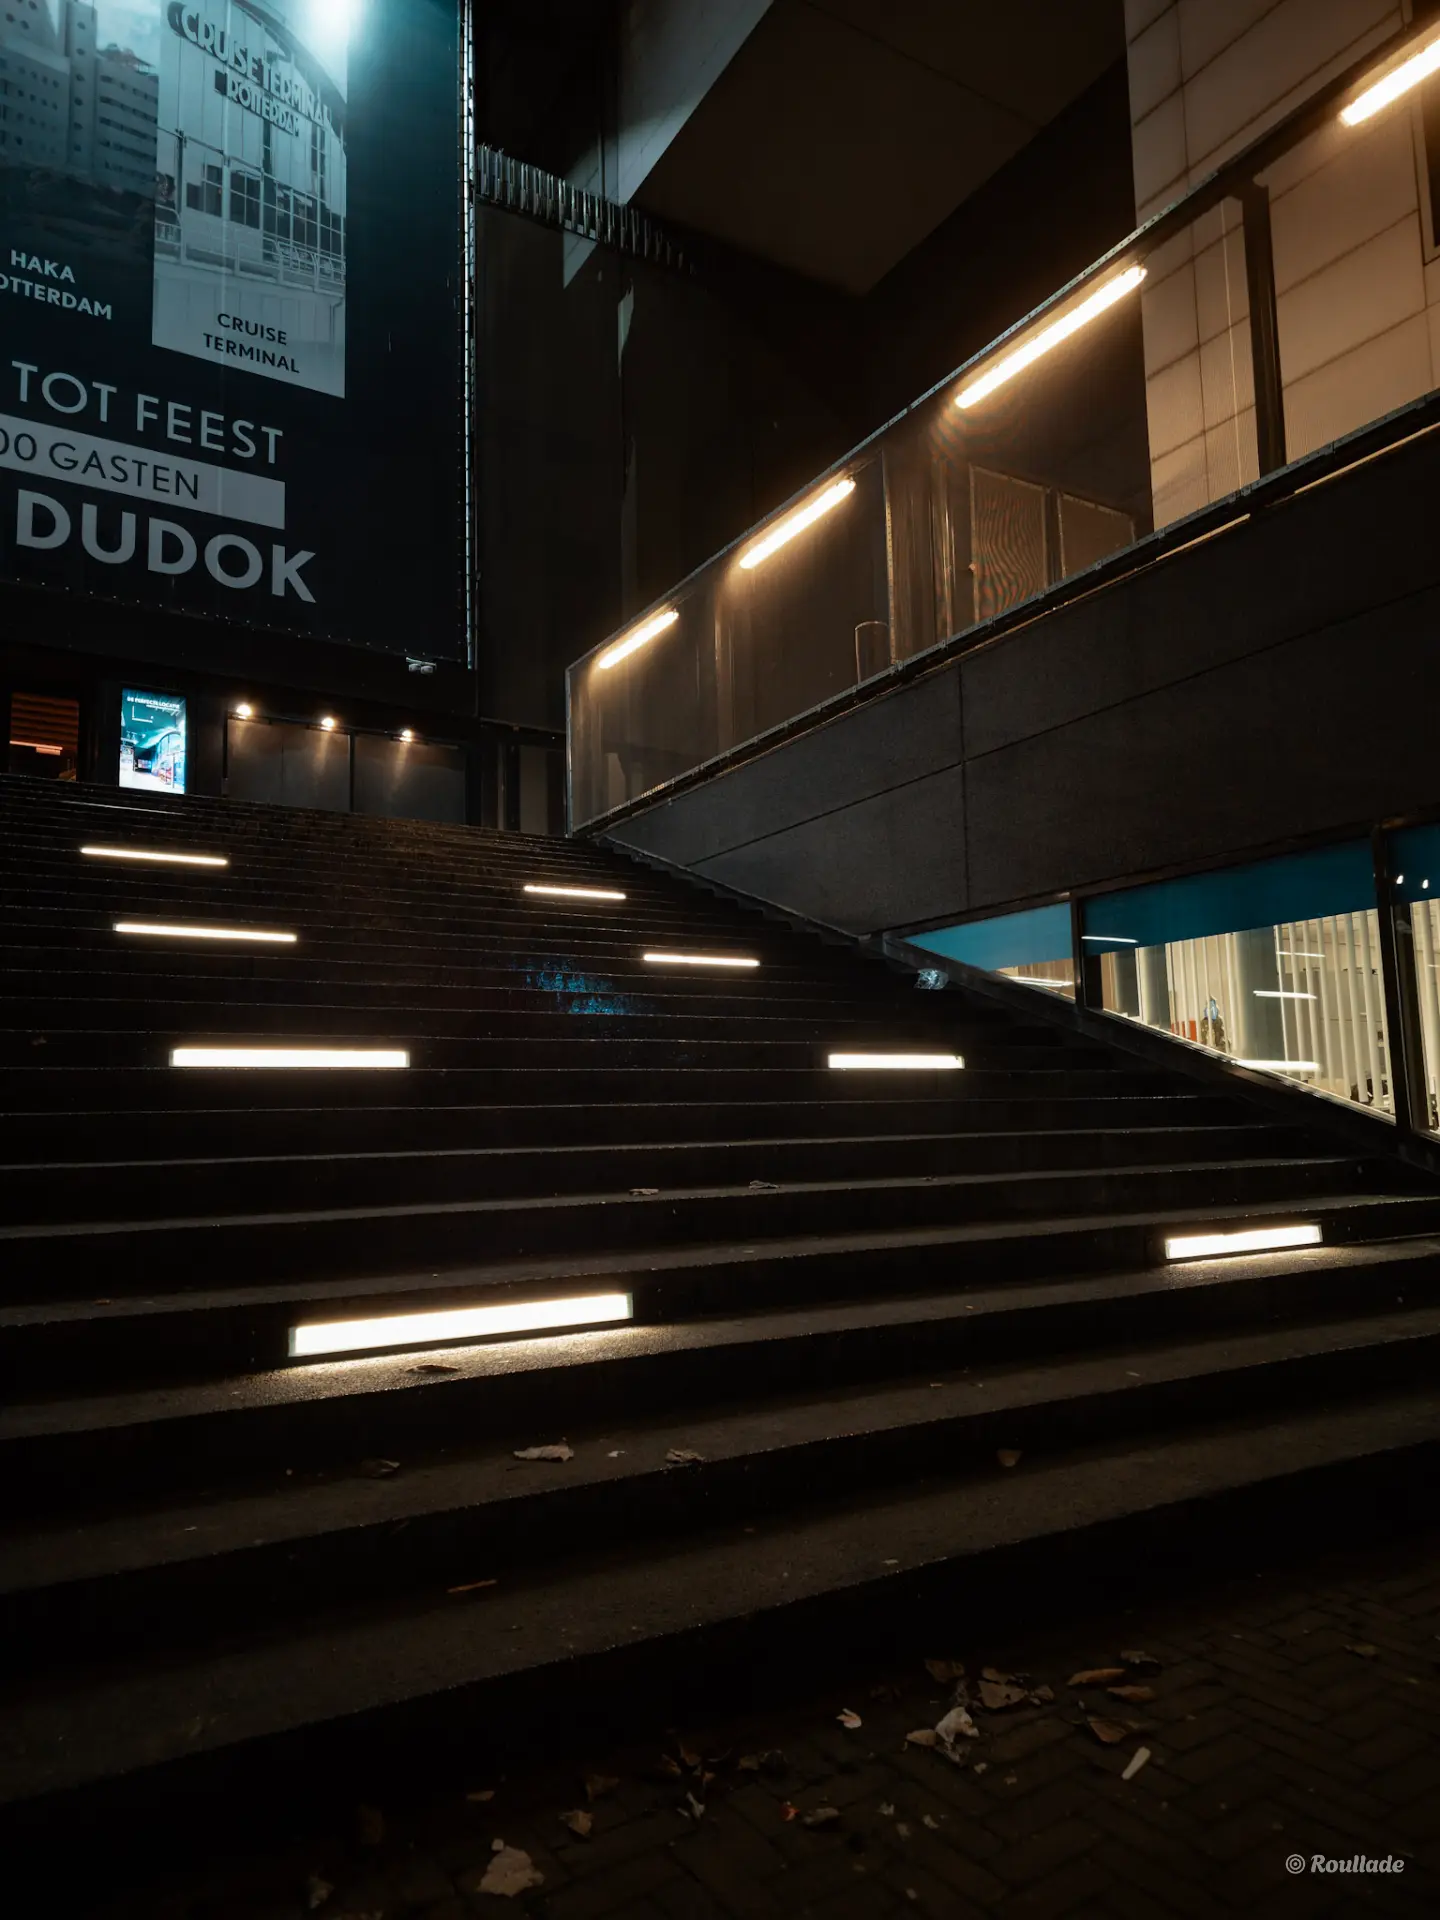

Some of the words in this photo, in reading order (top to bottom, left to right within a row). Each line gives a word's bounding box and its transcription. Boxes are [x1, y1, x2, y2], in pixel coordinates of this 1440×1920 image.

[174, 3, 263, 84] CRUISE
[261, 47, 332, 128] TERMINAL
[223, 71, 300, 137] ROTTERDAM
[11, 249, 76, 284] HAKA
[203, 332, 300, 374] TERMINAL
[217, 313, 287, 346] CRUISE
[12, 361, 117, 422] TOT
[136, 393, 283, 464] FEEST
[49, 442, 199, 500] GASTEN
[16, 488, 317, 603] DUDOK
